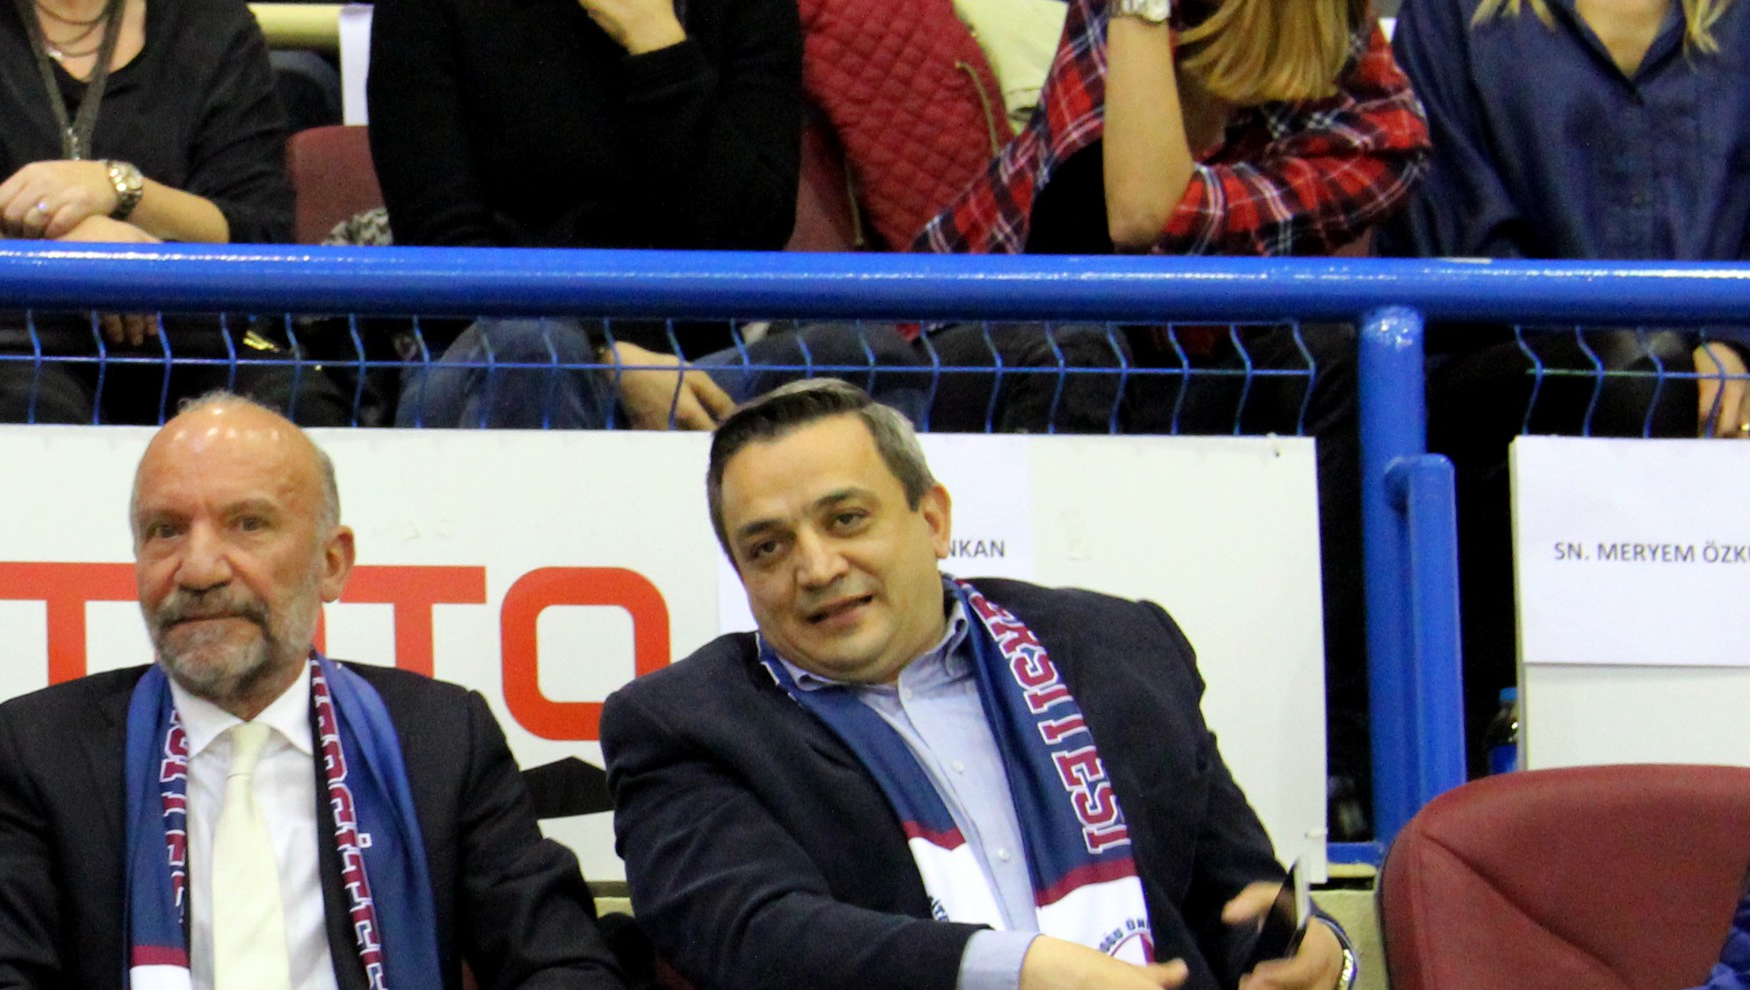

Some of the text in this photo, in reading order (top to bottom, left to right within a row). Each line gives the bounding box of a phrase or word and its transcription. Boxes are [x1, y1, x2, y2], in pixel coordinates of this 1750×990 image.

[1554, 539, 1750, 563] SN. MERYEM ÖZK
